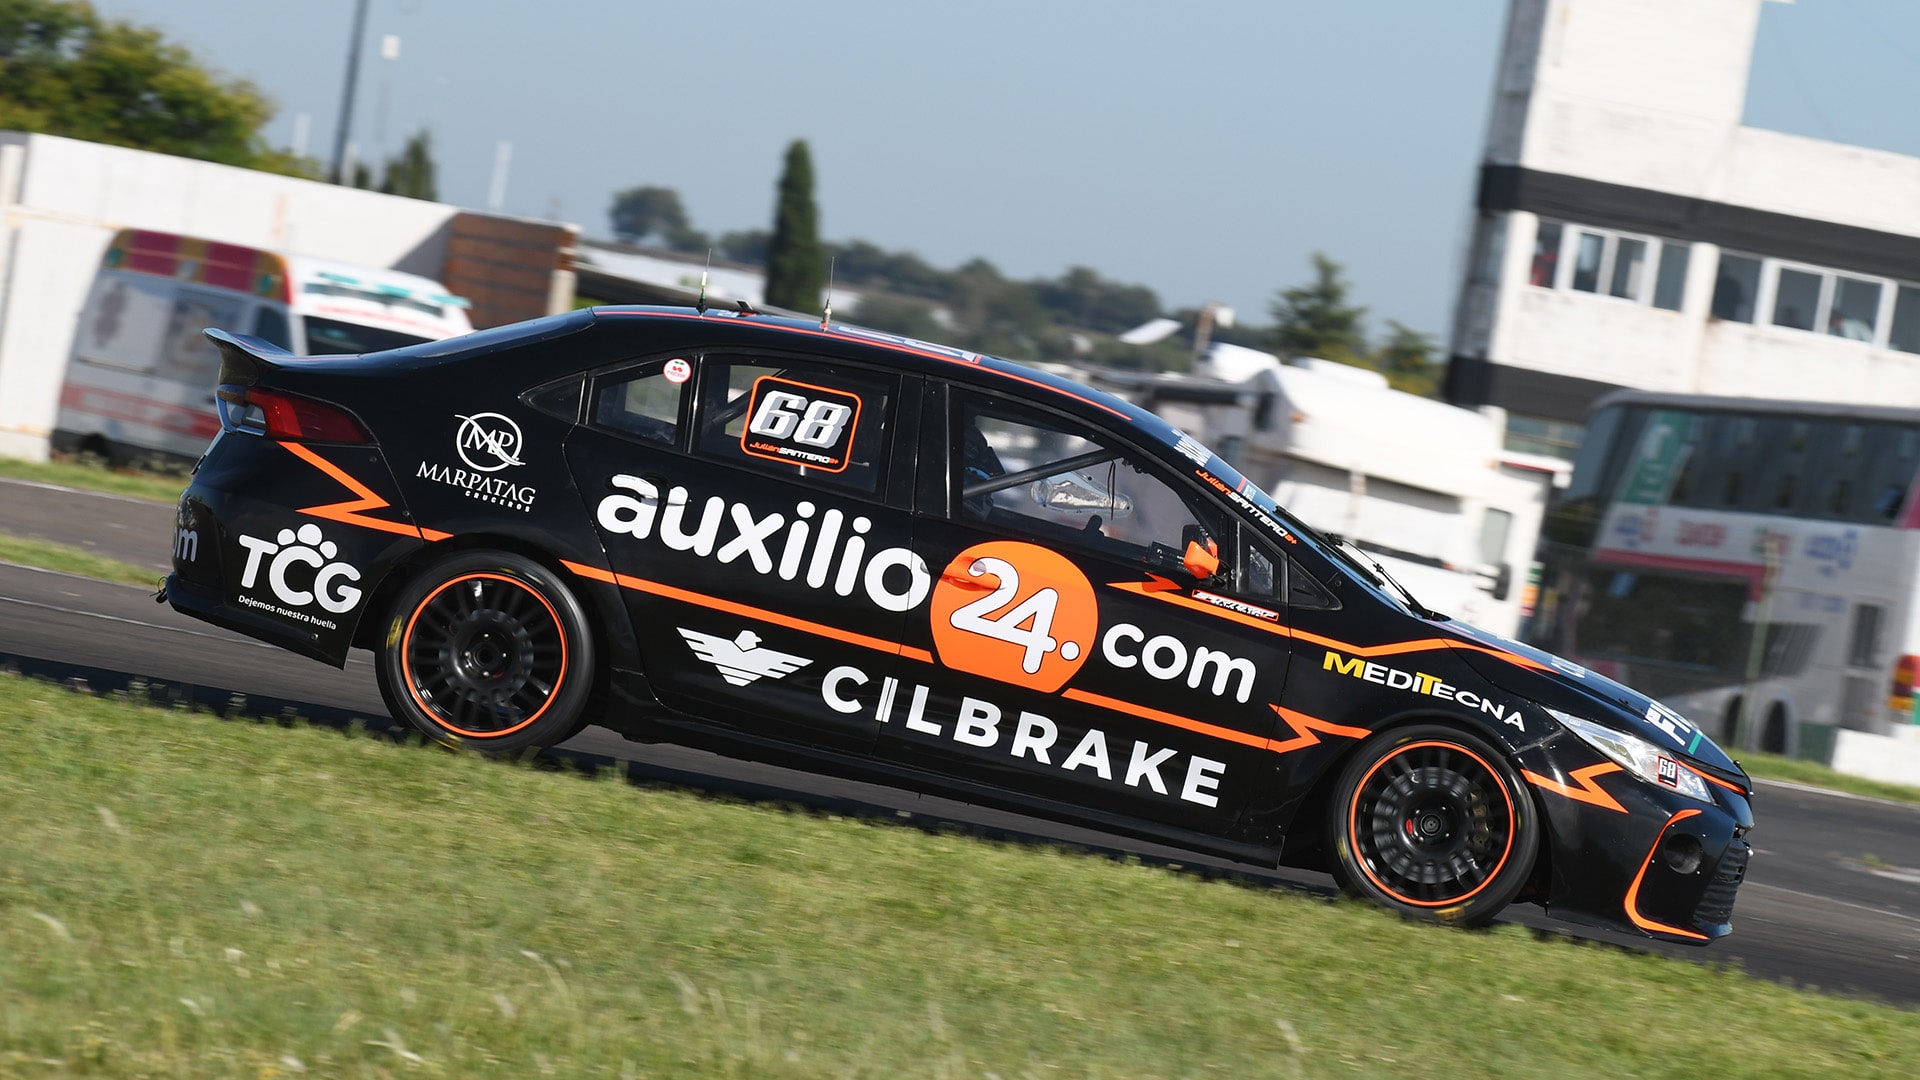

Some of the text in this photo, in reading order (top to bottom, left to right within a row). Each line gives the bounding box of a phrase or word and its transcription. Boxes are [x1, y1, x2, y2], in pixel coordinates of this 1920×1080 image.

[749, 390, 852, 449] 68
[416, 460, 536, 505] MARPATAG
[465, 490, 530, 512] CRUCEROS
[239, 534, 362, 614] TCG
[238, 594, 337, 631] Dejemos nuestra huella
[1322, 651, 1526, 732] MEDITECNA
[822, 666, 1227, 808] CILBRAKE
[1658, 758, 1677, 779] 68
